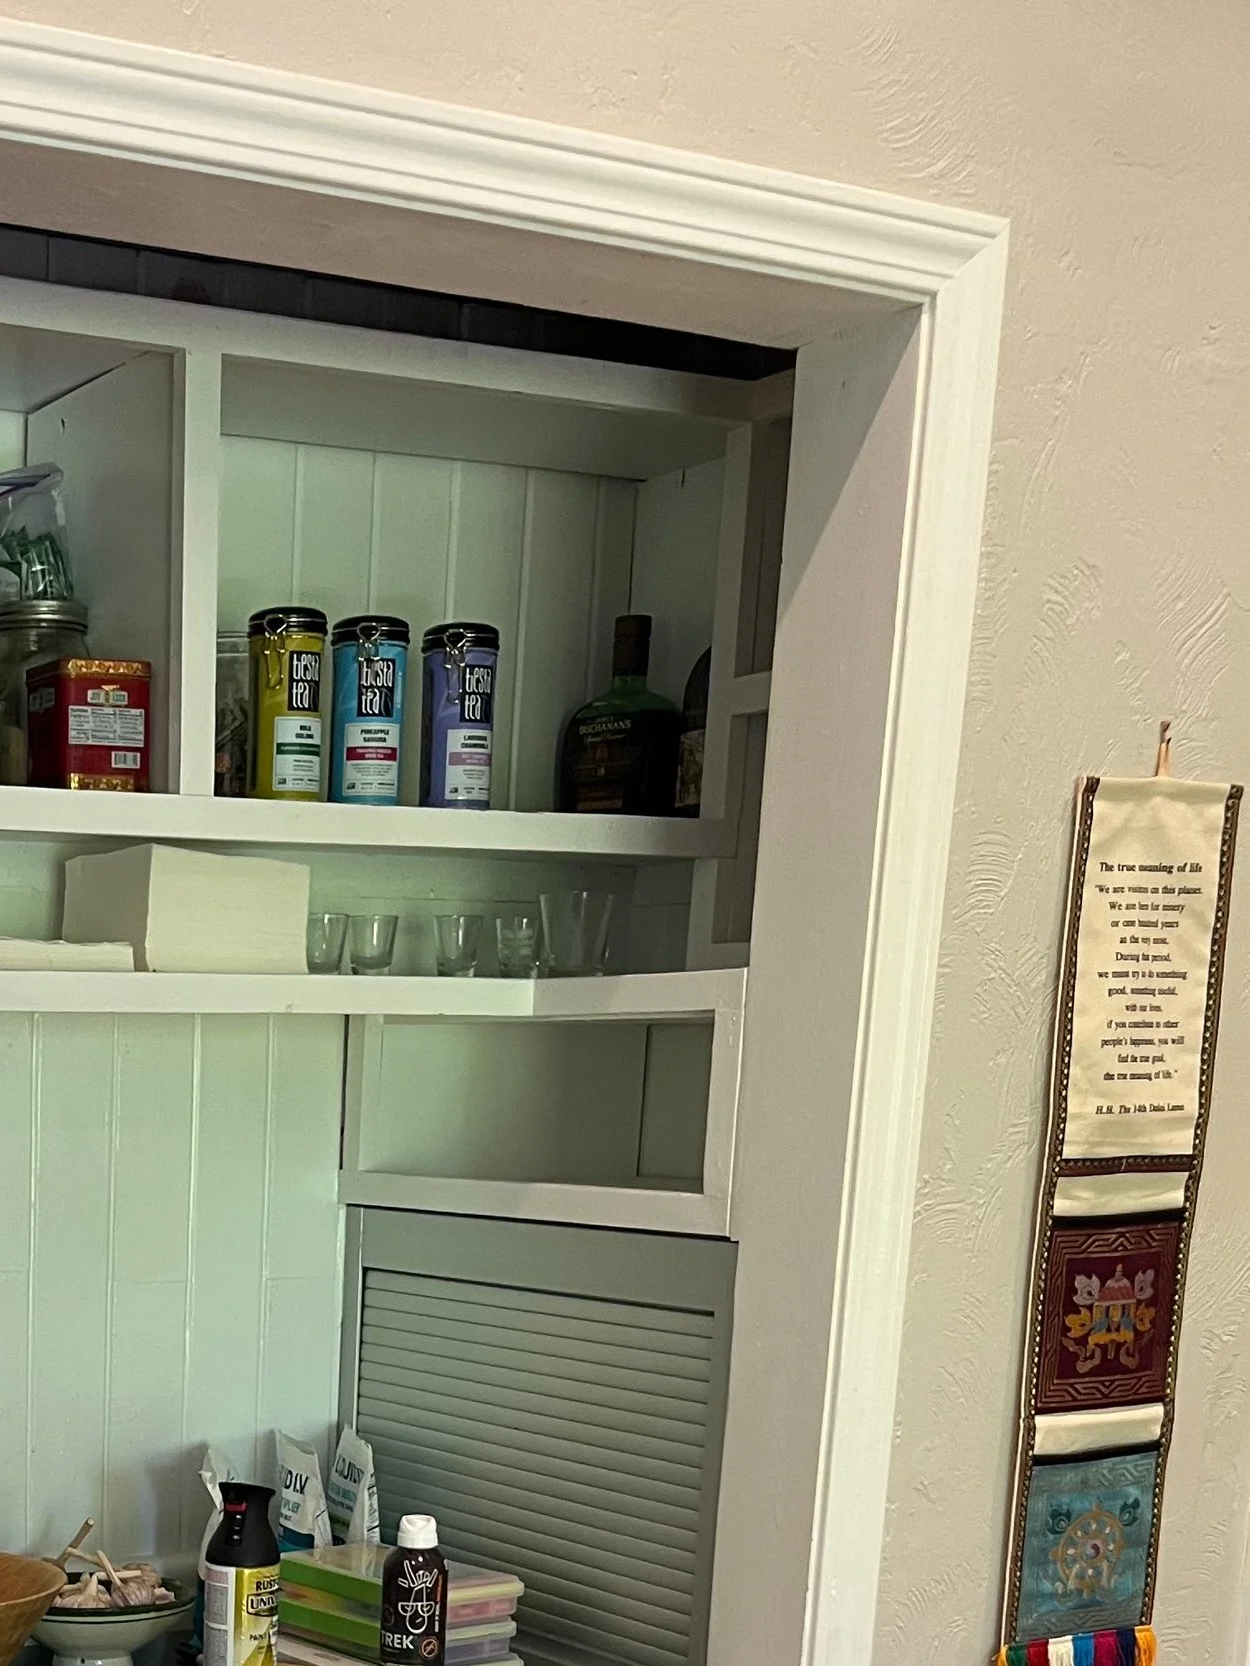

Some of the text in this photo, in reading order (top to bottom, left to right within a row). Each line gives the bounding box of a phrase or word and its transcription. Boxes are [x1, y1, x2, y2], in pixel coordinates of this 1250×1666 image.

[292, 681, 310, 708] tea
[464, 694, 481, 720] tea
[1099, 862, 1114, 872] The
[1118, 863, 1136, 872] true
[1177, 862, 1188, 872] of
[1189, 862, 1203, 872] life
[1108, 901, 1122, 910] We
